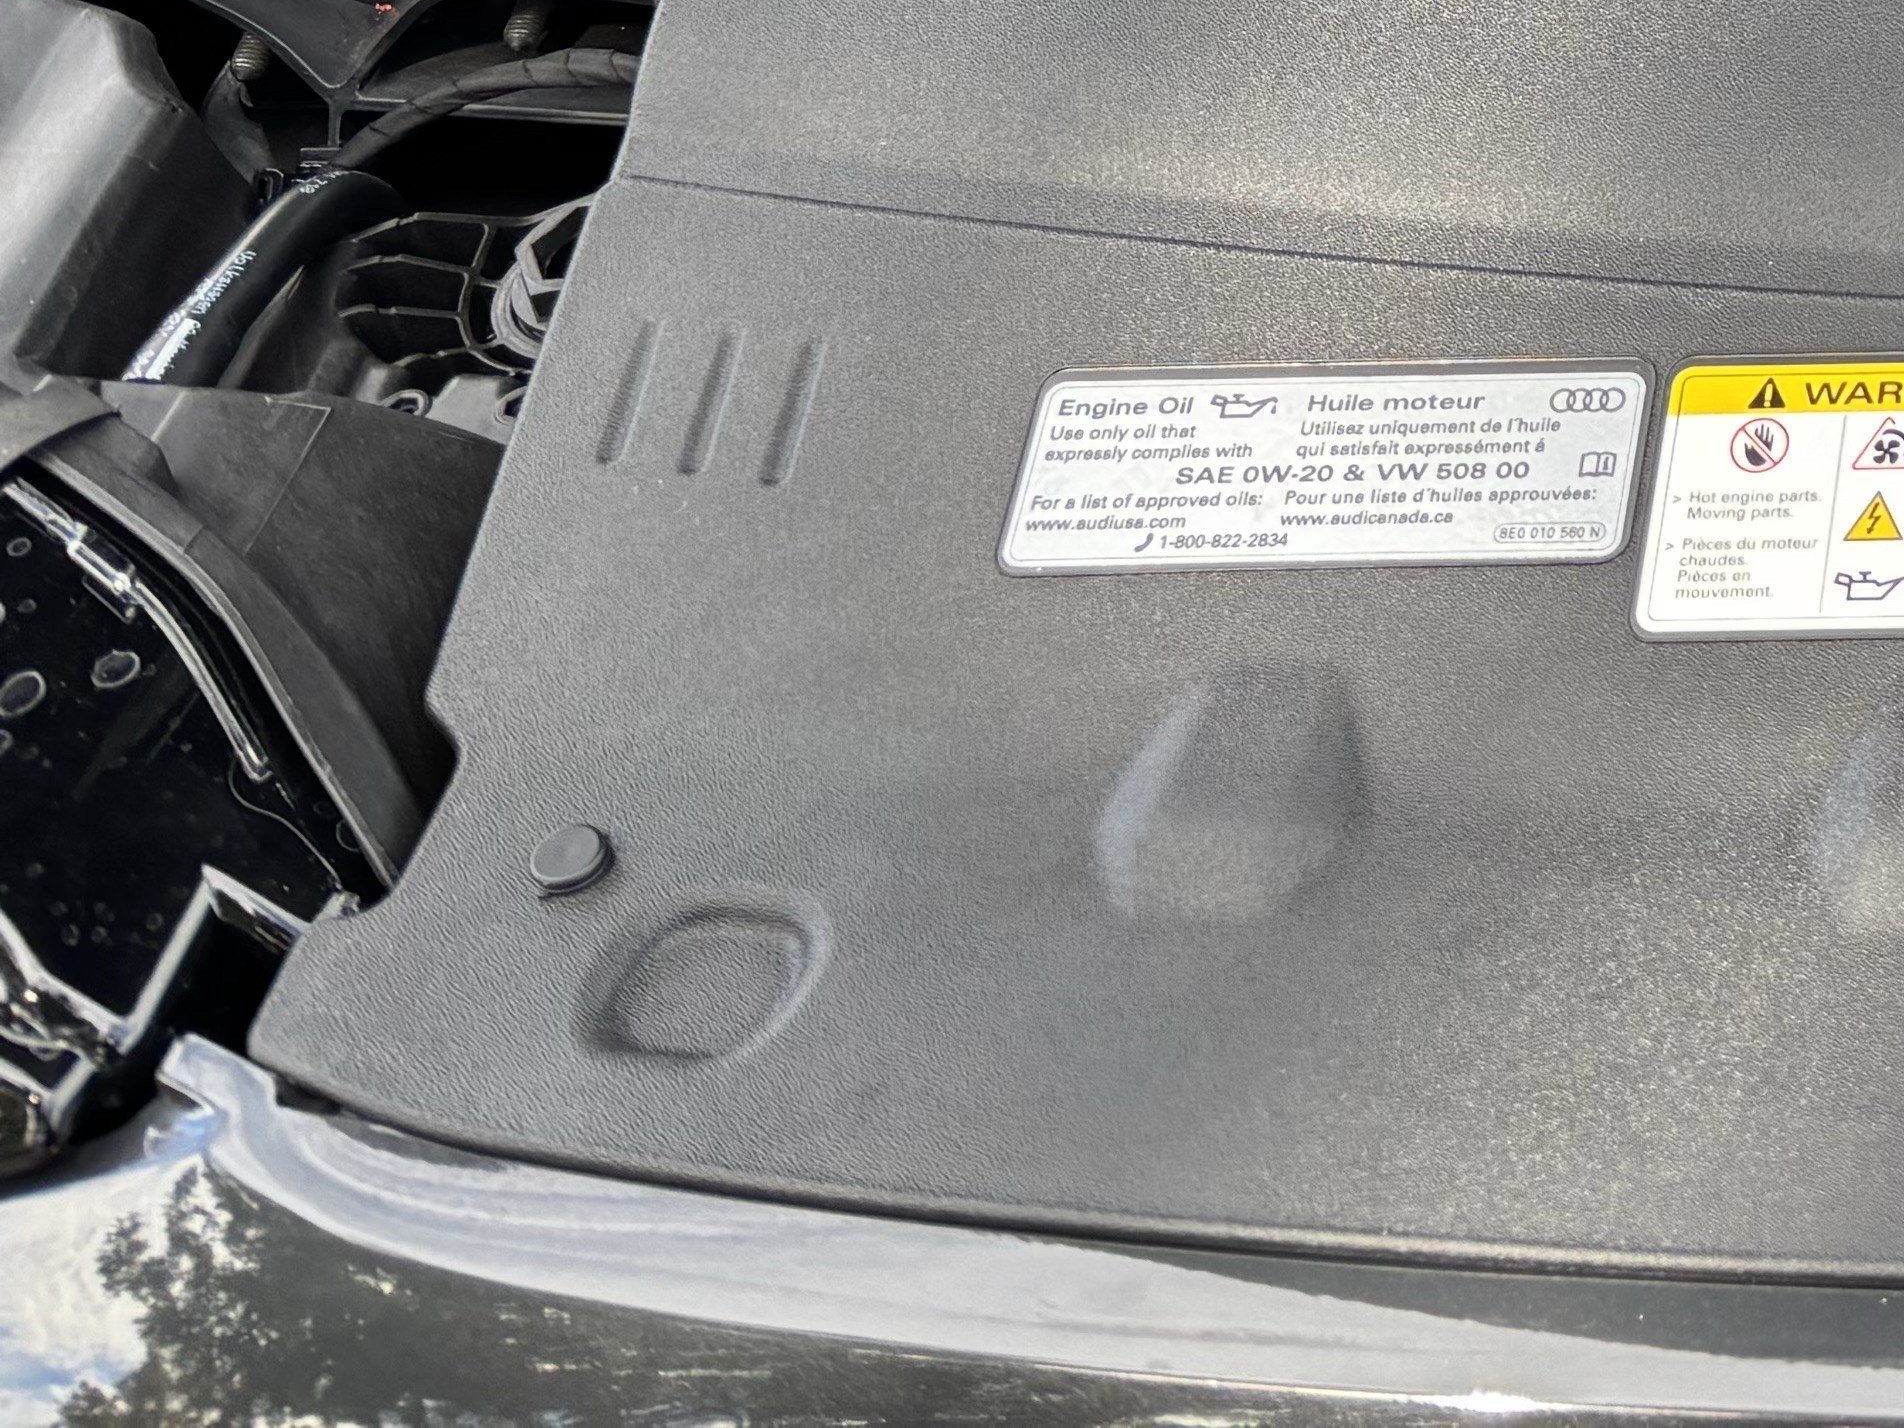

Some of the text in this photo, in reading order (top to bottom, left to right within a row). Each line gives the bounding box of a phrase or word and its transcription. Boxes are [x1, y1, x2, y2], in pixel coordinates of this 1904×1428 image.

[1058, 397, 1194, 419] Engine Oil
[1307, 394, 1486, 412] Huile moteur
[1050, 424, 1196, 442] Use only oil that
[1301, 421, 1364, 436] Utilisez
[1369, 421, 1475, 437] uniquement
[1480, 418, 1501, 433] de
[1045, 443, 1252, 464] expressly complies with
[1296, 443, 1325, 459] qui
[1330, 442, 1399, 456] satisfait
[1404, 440, 1530, 457] expressément
[1175, 466, 1235, 485] SAE
[1343, 465, 1365, 481] &
[1377, 463, 1429, 481] VW
[1436, 462, 1487, 480] 508
[1496, 462, 1530, 479] 00
[1031, 491, 1263, 511] For a list of approved oils:
[1285, 491, 1327, 506] Pour
[1332, 492, 1364, 504] une
[1370, 488, 1407, 504] liste
[1488, 486, 1597, 504] approuvées:
[1688, 490, 1822, 505] Hot engine parts.
[1280, 511, 1454, 525] www.audicanada.ca
[1687, 507, 1794, 522] Moving parts.
[1025, 516, 1186, 531] www.audiusa.com
[1160, 533, 1288, 549] 1-800-822-2834
[1530, 527, 1555, 539] 010
[1560, 527, 1586, 538] 560
[1590, 527, 1600, 538] N
[1682, 537, 1819, 550] Pièces du moteur
[1679, 554, 1748, 566] chaudes.
[1677, 570, 1751, 582] Pièces en
[1675, 586, 1773, 598] mouvement.
